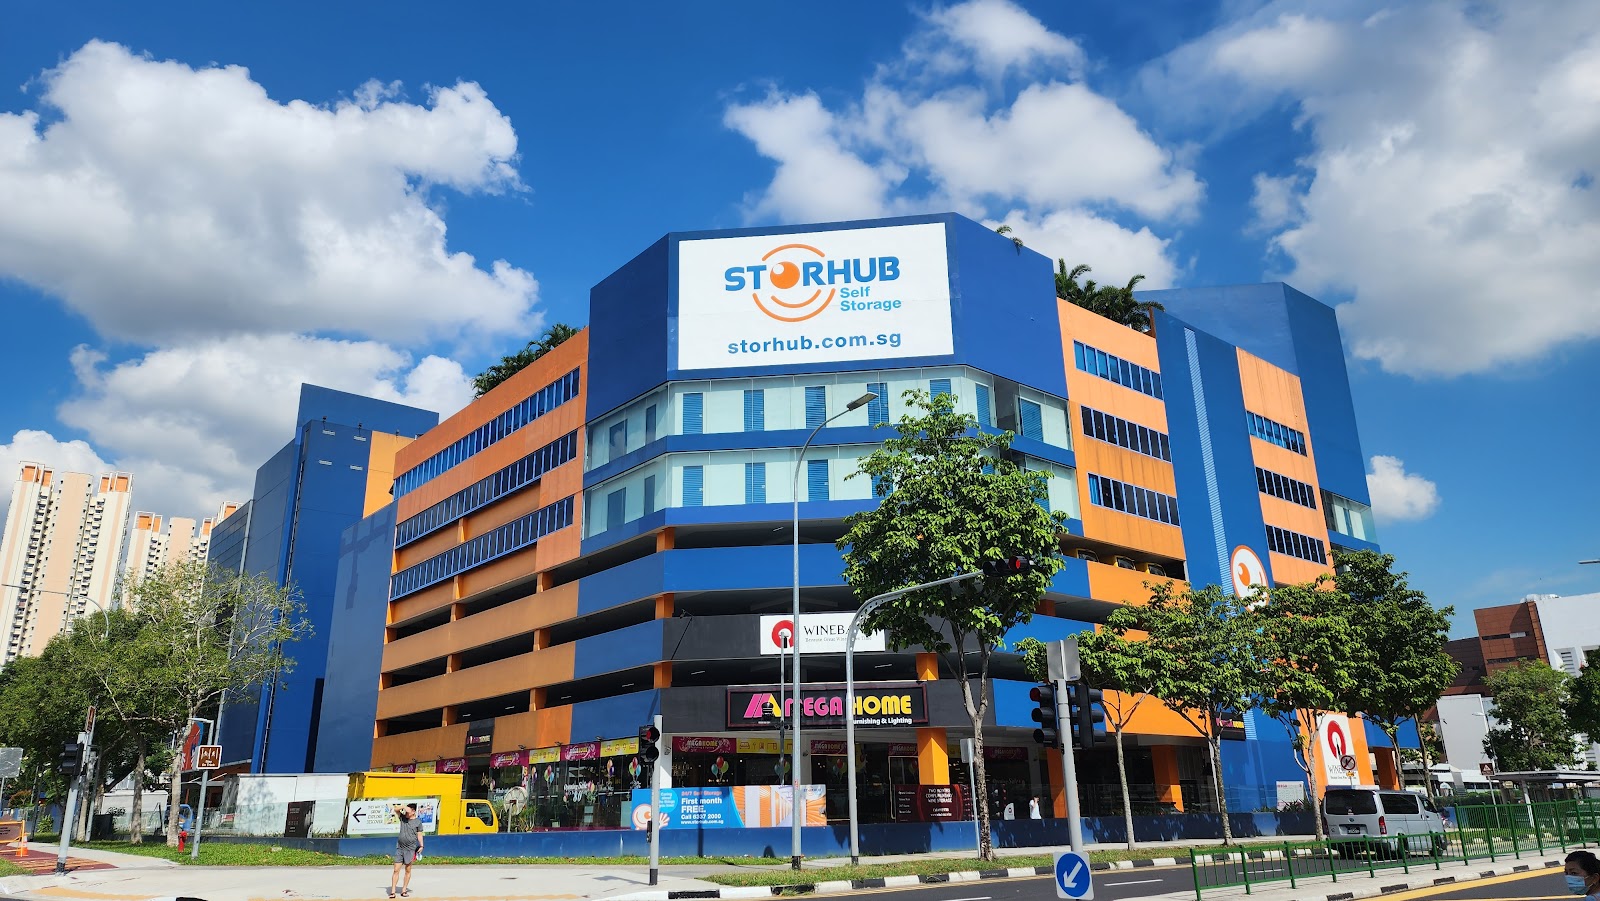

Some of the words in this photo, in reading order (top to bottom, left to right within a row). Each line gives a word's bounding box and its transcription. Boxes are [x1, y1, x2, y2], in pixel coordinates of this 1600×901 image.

[724, 256, 901, 292] STORHUB
[840, 286, 870, 298] Self
[840, 299, 902, 312] Storage
[728, 333, 901, 354] storhub.com.sg
[853, 695, 912, 716] HOME
[888, 717, 913, 725] Lighting
